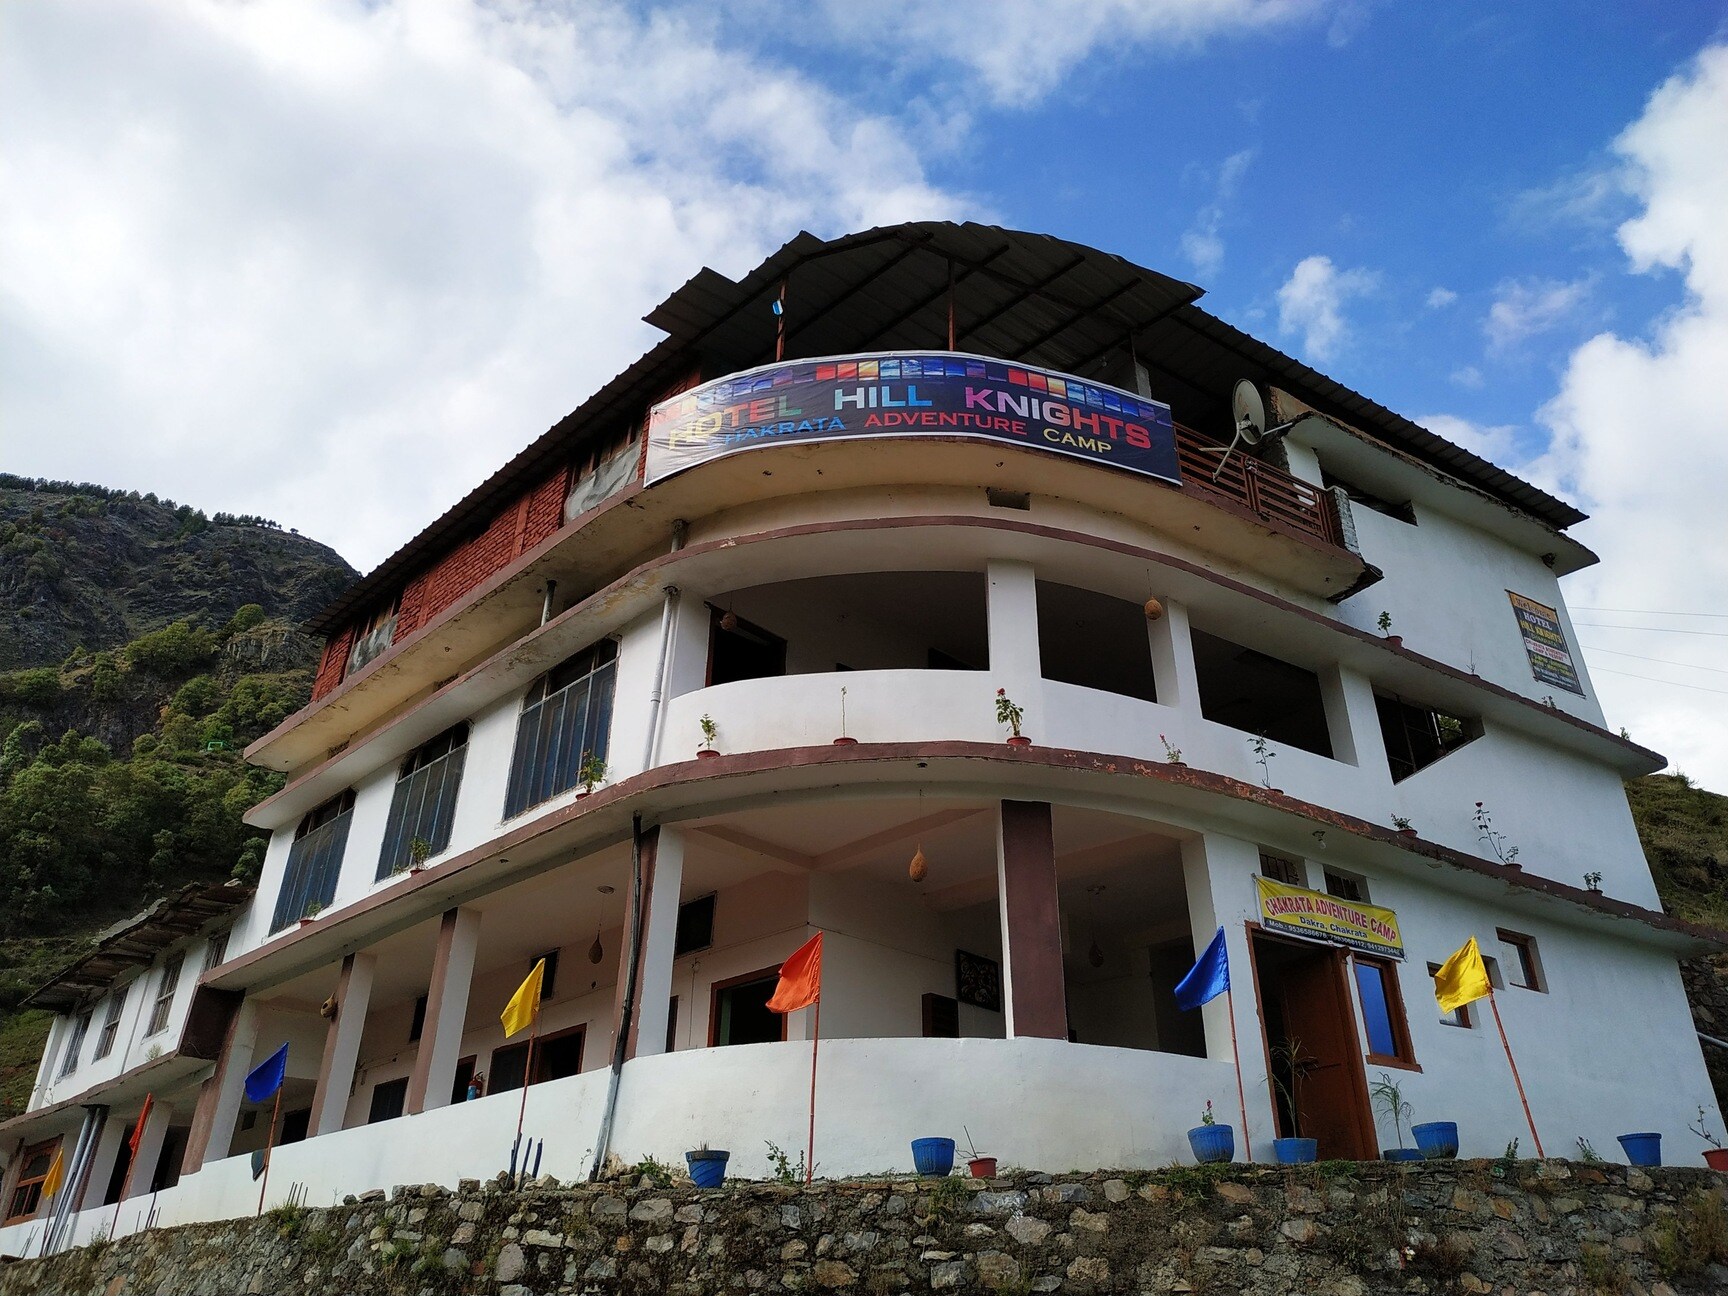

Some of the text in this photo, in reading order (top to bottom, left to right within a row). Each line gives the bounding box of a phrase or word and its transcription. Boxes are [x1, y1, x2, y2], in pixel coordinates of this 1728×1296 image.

[669, 385, 1152, 451] HOTEL HILL KNIGHTS
[864, 411, 1028, 436] ADVENTURE
[1043, 428, 1112, 453] CAMP
[1522, 611, 1553, 631] HOTEL
[1264, 896, 1397, 942] CHAKRATA ADVENTURE CAMP
[1299, 916, 1368, 939] Dakra, Chakrata
